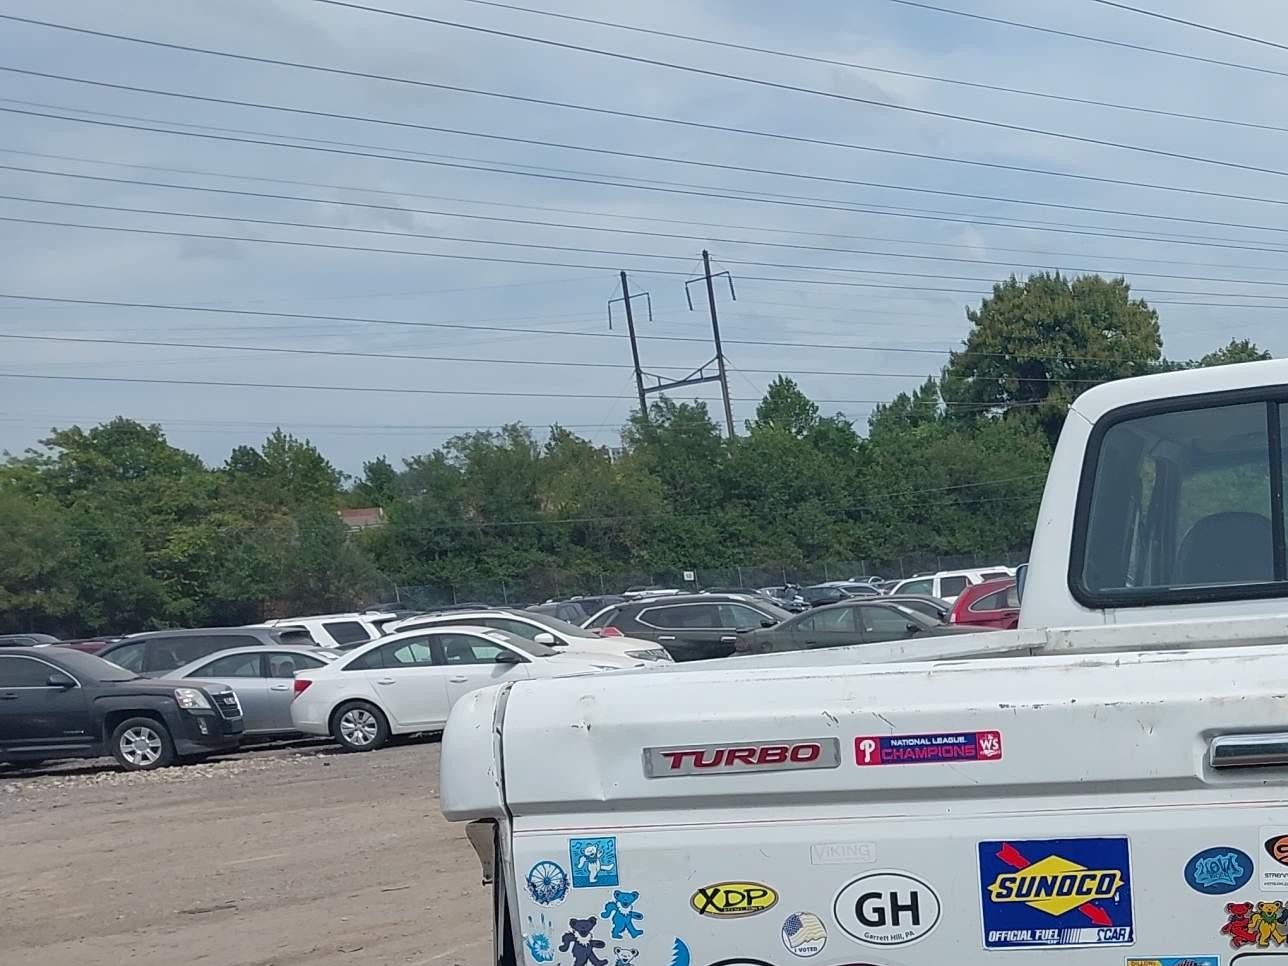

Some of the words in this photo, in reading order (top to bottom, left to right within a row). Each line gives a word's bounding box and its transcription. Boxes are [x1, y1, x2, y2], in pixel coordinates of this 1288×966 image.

[891, 738, 931, 746] NATIONAL
[932, 736, 967, 744] LEAGUE
[662, 743, 823, 769] TURBO
[881, 745, 976, 760] CHAMPIONS
[996, 873, 1117, 898] SUNOCO
[697, 888, 768, 915] XDP
[855, 891, 921, 927] GH
[864, 931, 890, 942] Garrett
[905, 930, 915, 939] PA
[988, 930, 1033, 942] OFFICIAL
[1035, 929, 1060, 940] FUEL
